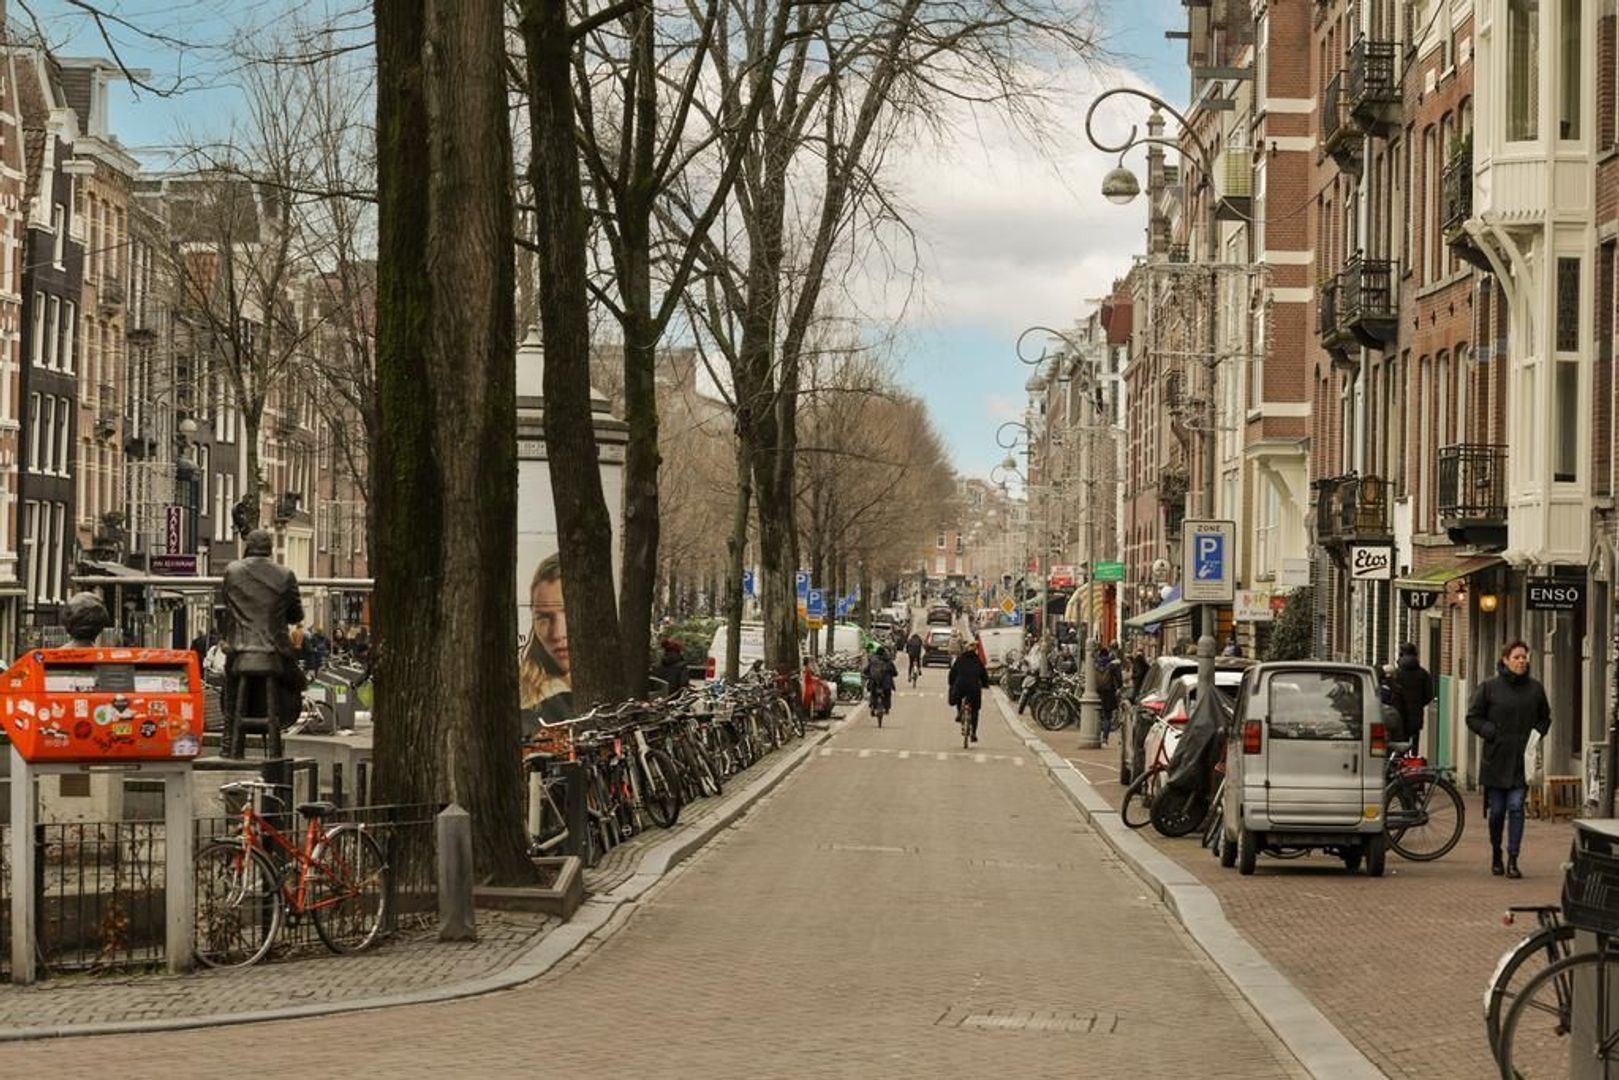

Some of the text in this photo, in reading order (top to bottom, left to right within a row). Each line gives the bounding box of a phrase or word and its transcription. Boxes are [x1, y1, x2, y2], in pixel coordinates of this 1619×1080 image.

[1200, 538, 1218, 561] P
[1355, 549, 1388, 568] Etos
[810, 592, 820, 605] P
[1410, 592, 1430, 607] RT
